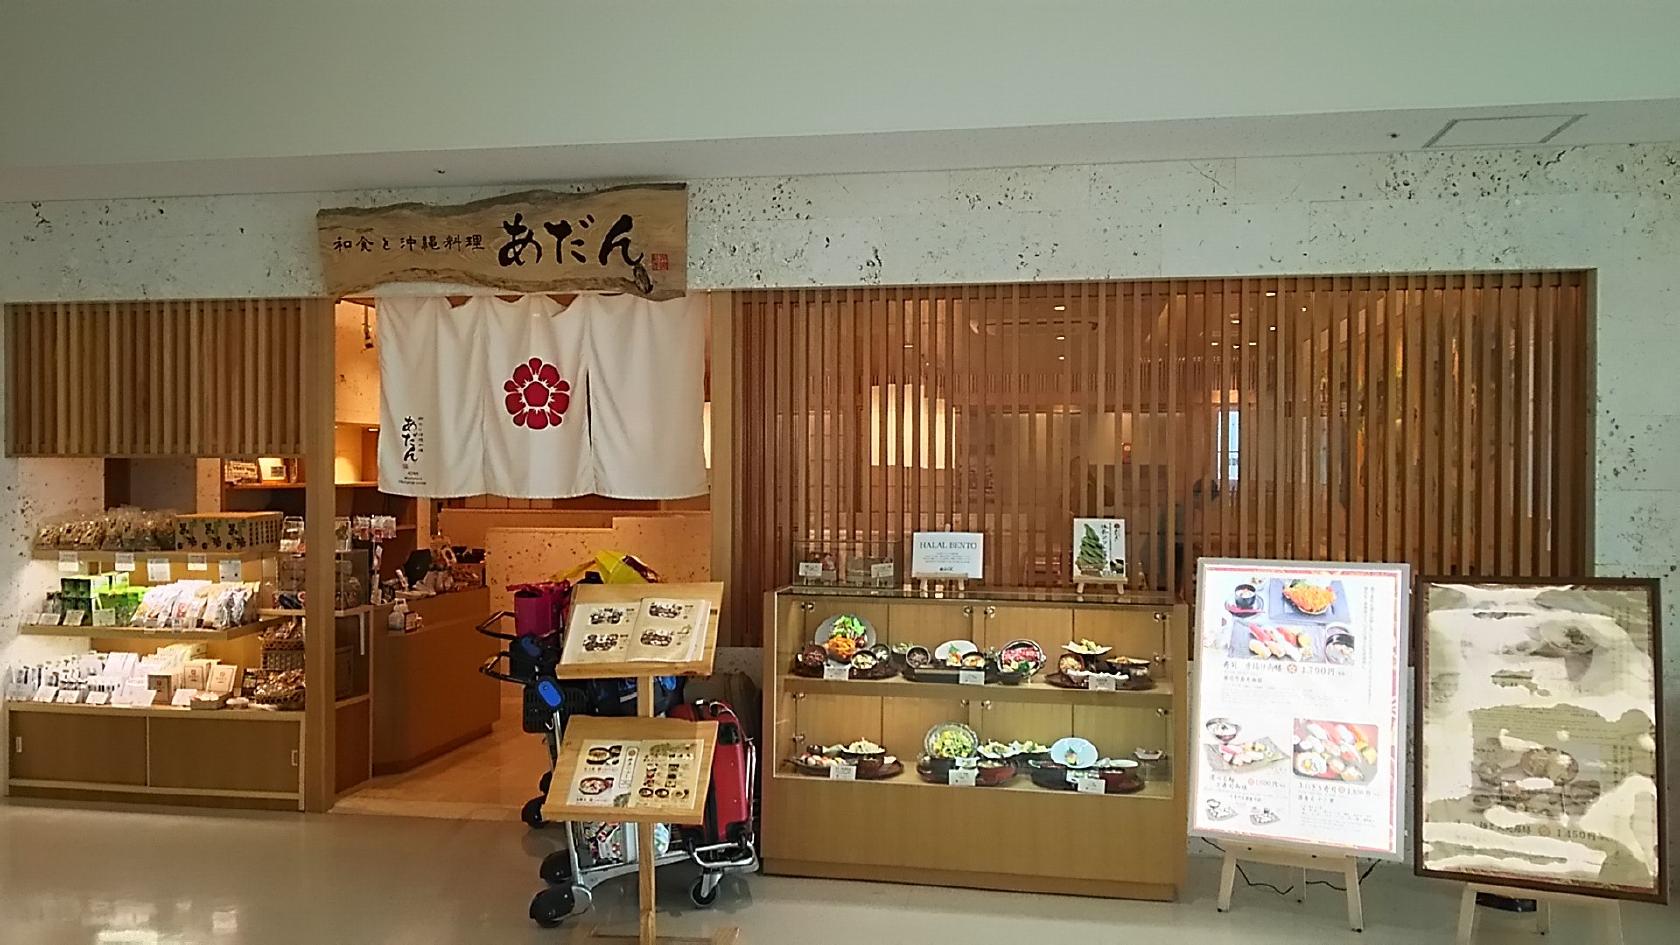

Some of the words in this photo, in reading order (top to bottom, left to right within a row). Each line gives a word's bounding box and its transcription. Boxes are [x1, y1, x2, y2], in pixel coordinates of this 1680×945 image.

[333, 234, 486, 253] 和食と沖縄料理
[498, 212, 644, 267] あだん
[402, 416, 418, 462] あだん
[919, 541, 947, 549] HALAL
[949, 541, 978, 550] BENTO
